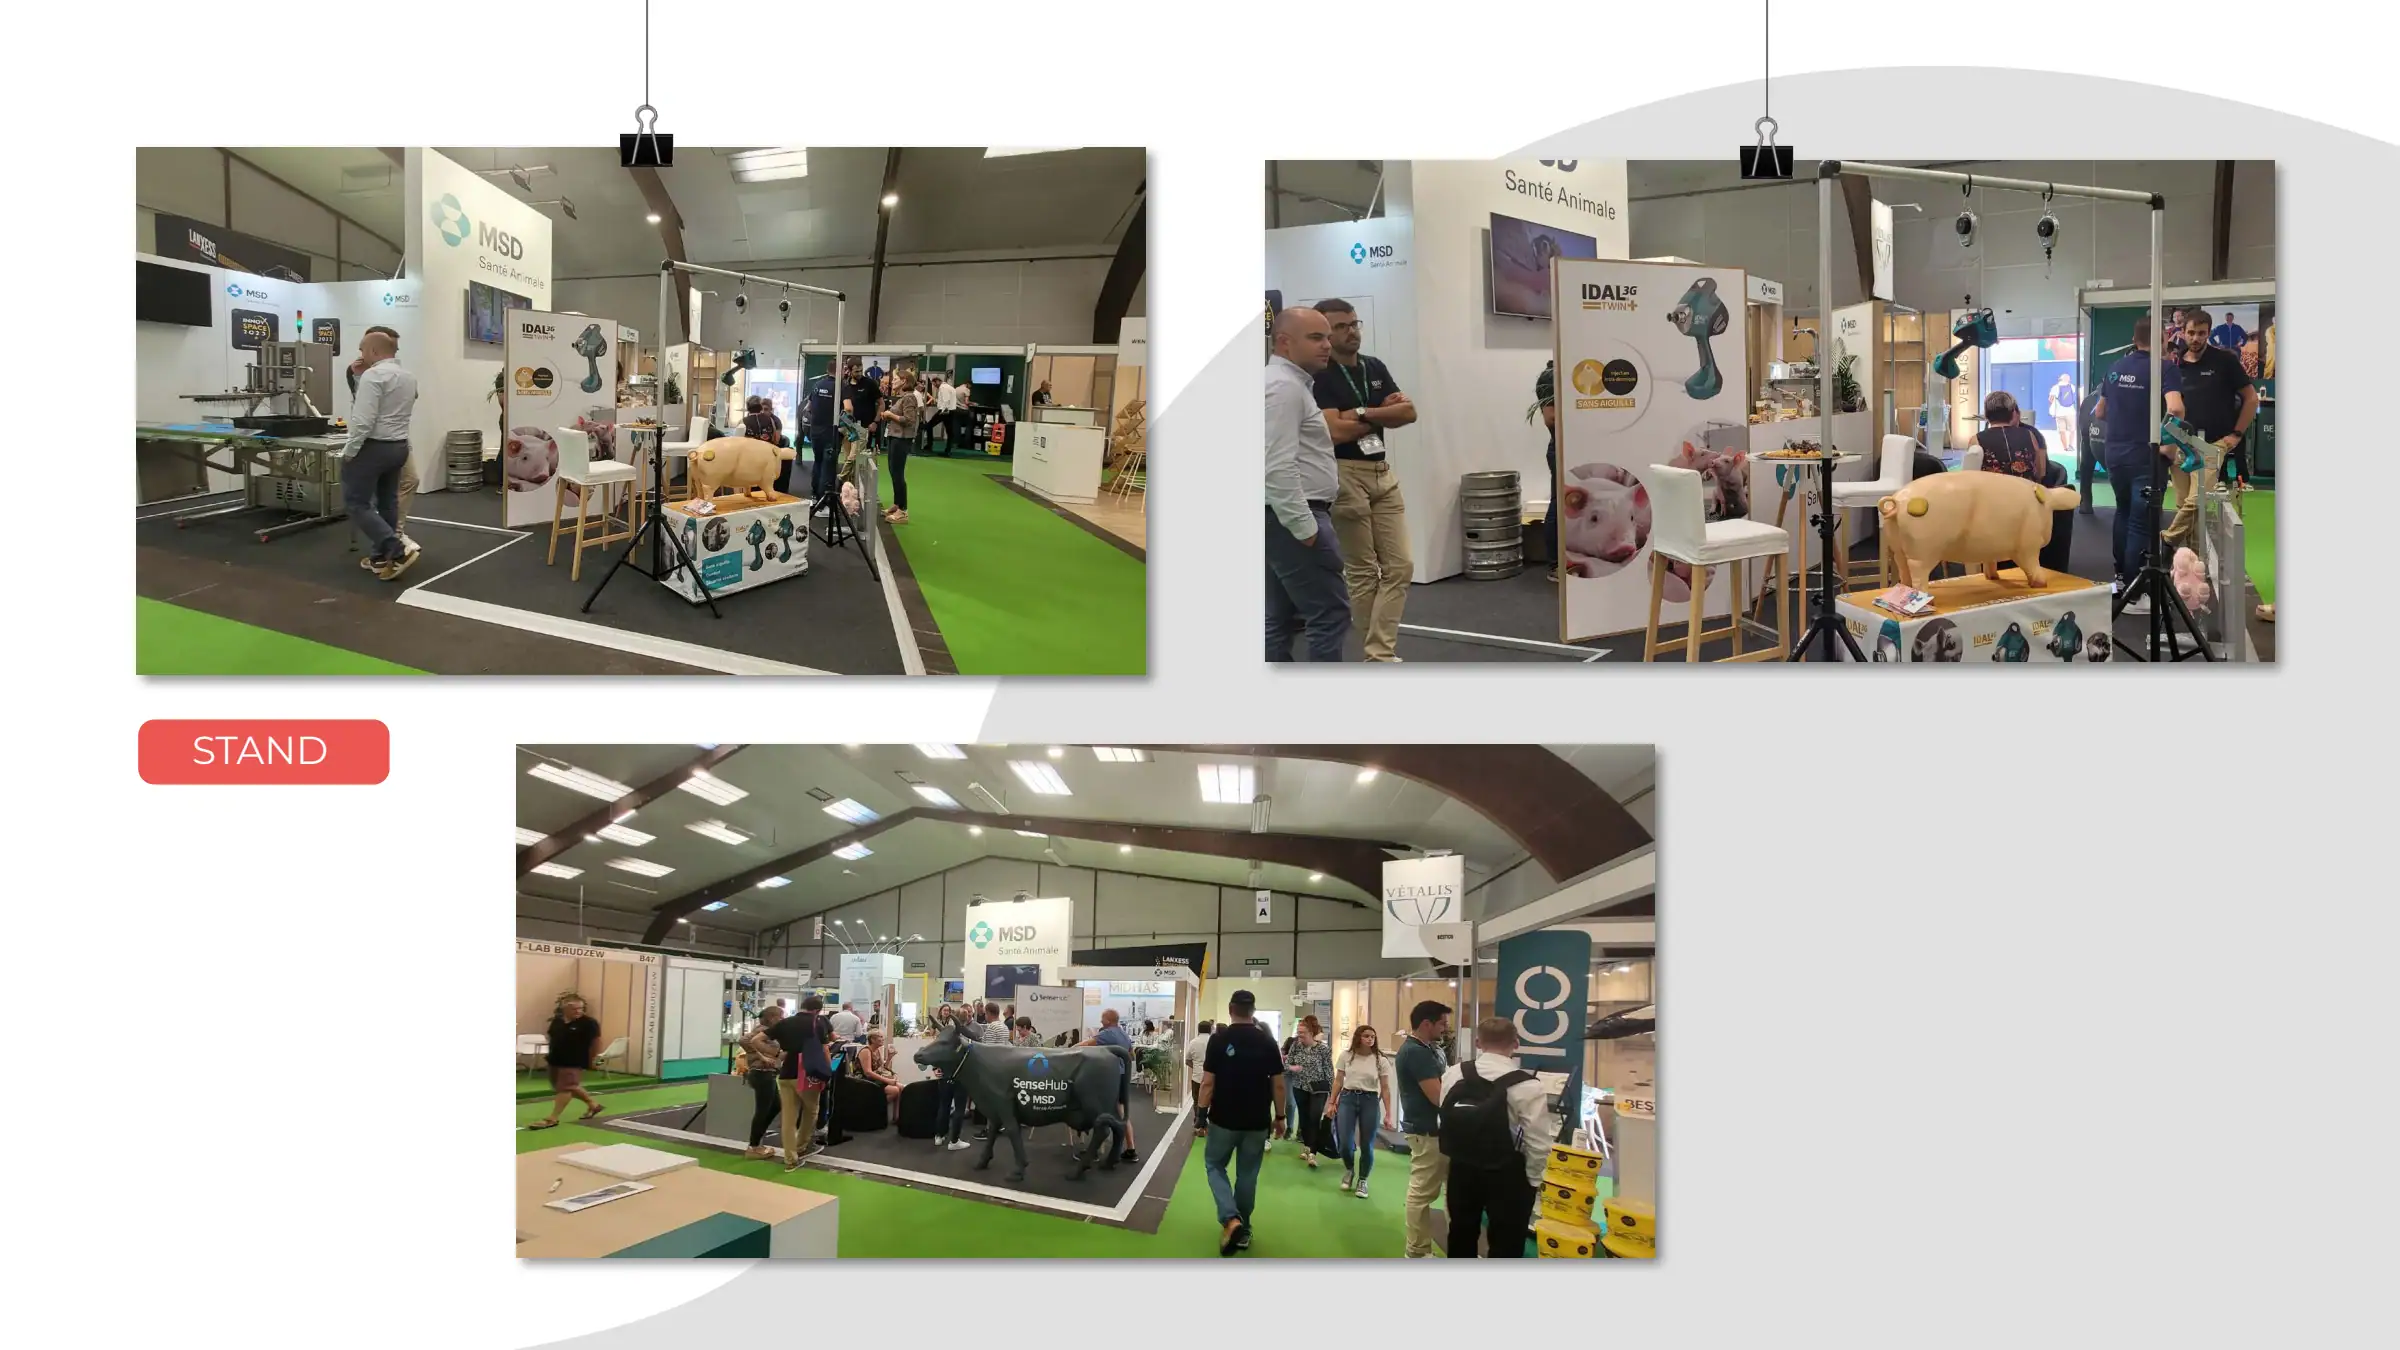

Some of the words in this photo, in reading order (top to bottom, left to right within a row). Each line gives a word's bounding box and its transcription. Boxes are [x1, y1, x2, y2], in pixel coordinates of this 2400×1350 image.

[1505, 170, 1553, 202] Santé
[1557, 186, 1616, 220] Animale
[479, 220, 524, 261] MSD
[1369, 245, 1393, 258] MSD
[479, 255, 508, 276] Santé
[509, 268, 545, 290] Animale
[246, 289, 268, 300] MSD
[1582, 284, 1626, 301] IDAL
[395, 295, 410, 303] MSD
[243, 323, 267, 332] SPACE
[522, 323, 548, 335] IDAL
[2120, 374, 2135, 383] MSD
[1259, 908, 1268, 917] A
[999, 926, 1037, 942] MSD
[554, 946, 605, 958] BRUDZEW
[998, 947, 1021, 955] Santé
[1023, 946, 1059, 955] Animale
[639, 955, 656, 963] B47
[1162, 956, 1190, 965] LANXESS
[1512, 965, 1572, 1069] ICO
[1032, 1095, 1056, 1105] MSD
[1624, 1098, 1655, 1111] BES
